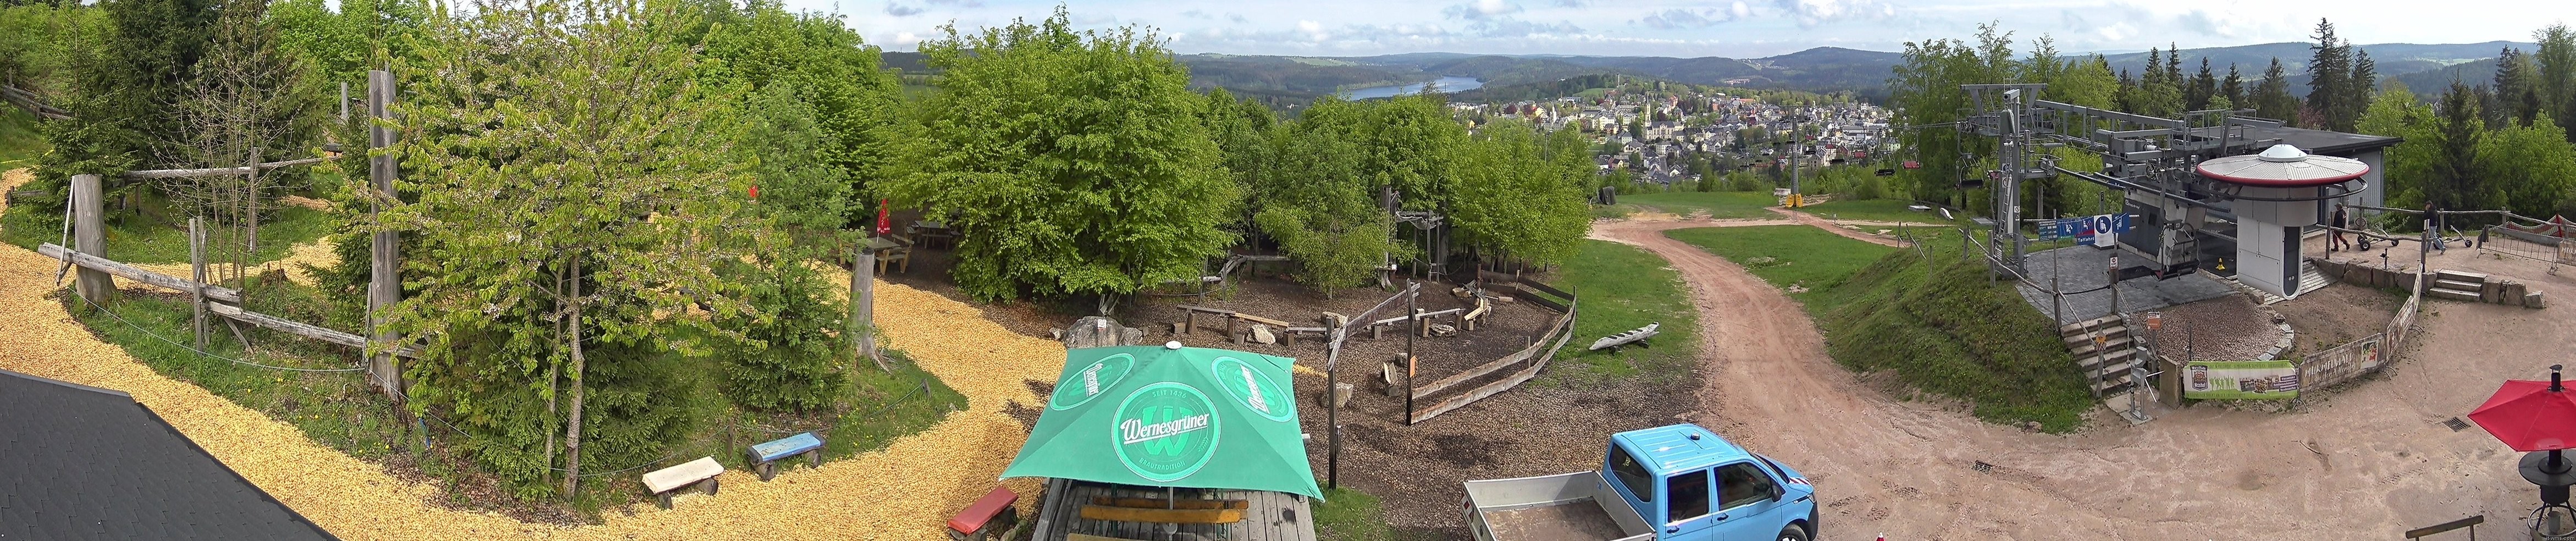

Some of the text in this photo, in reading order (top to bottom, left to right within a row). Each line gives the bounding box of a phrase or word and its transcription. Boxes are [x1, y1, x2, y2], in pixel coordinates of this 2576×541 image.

[1170, 390, 1186, 399] 1436
[1120, 413, 1210, 440] Wernesgrüner
[1139, 457, 1186, 470] BRAUTRADITION
